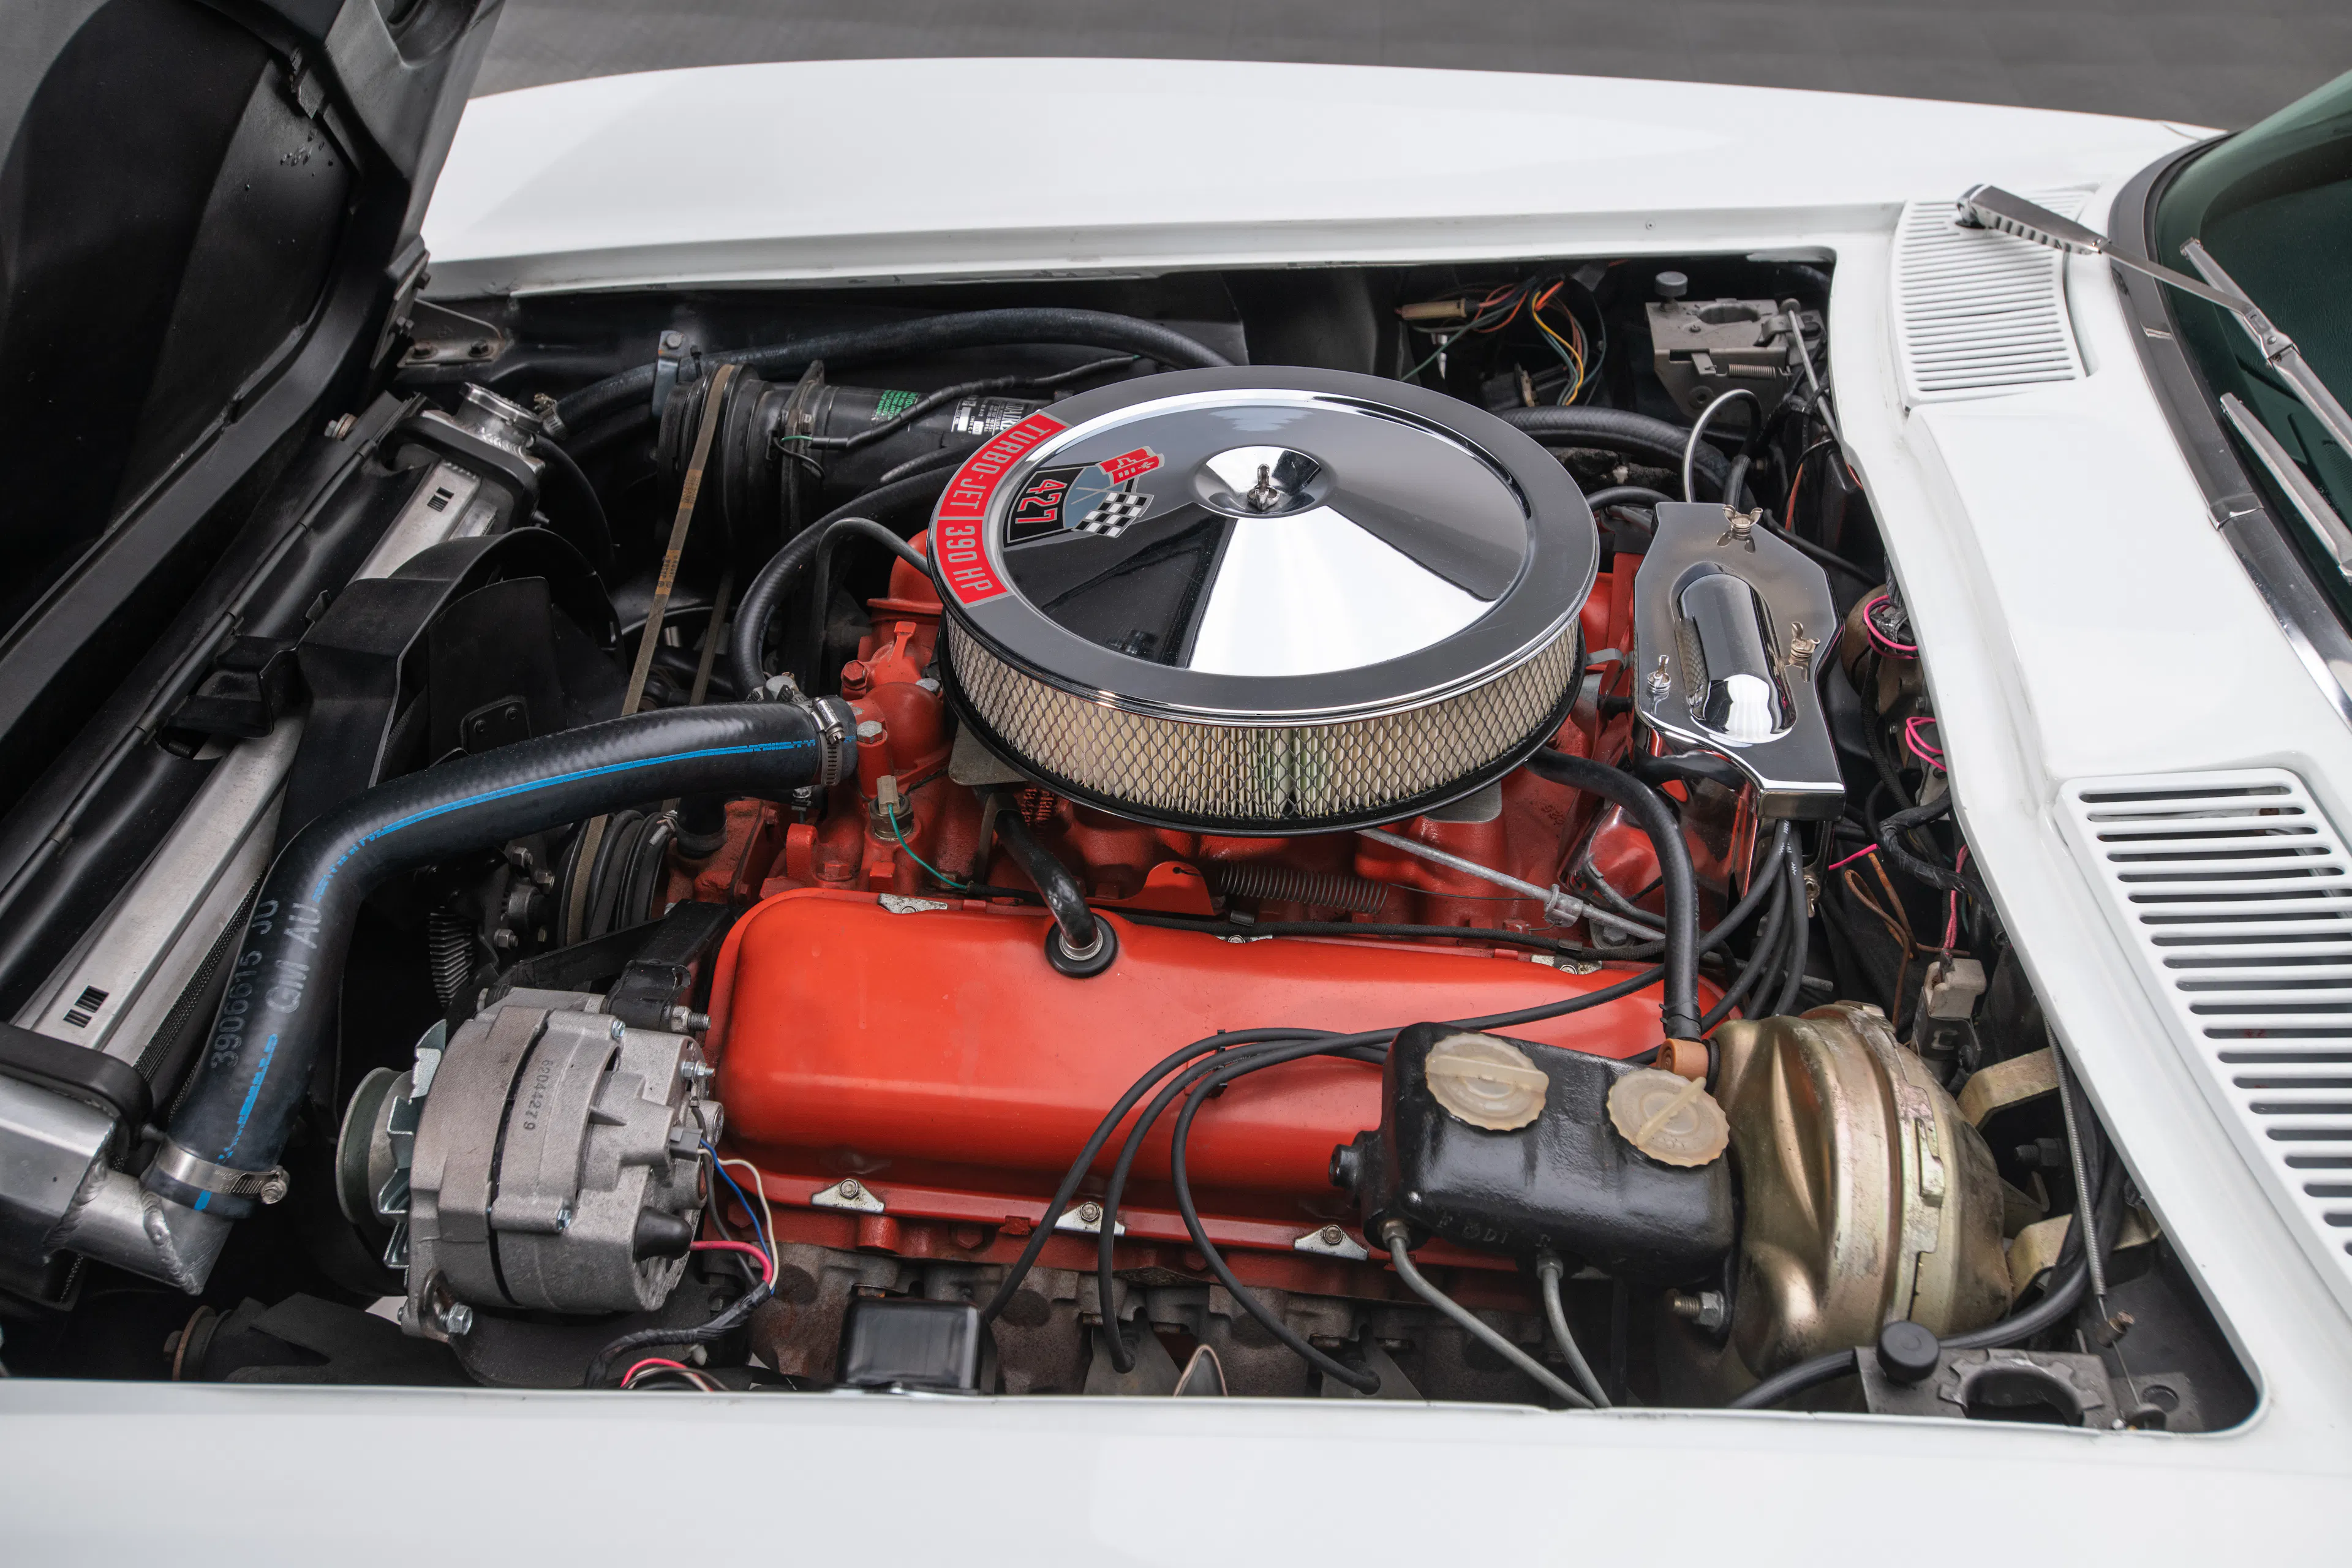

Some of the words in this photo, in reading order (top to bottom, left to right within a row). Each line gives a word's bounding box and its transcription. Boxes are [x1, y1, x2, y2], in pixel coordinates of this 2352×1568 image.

[950, 424, 1051, 510] TURBO-JET
[1014, 479, 1068, 524] 427
[945, 526, 978, 563] 390
[952, 567, 993, 591] HP
[284, 902, 323, 950] AU
[265, 958, 310, 1013] GM
[209, 953, 262, 1067] 3906615
